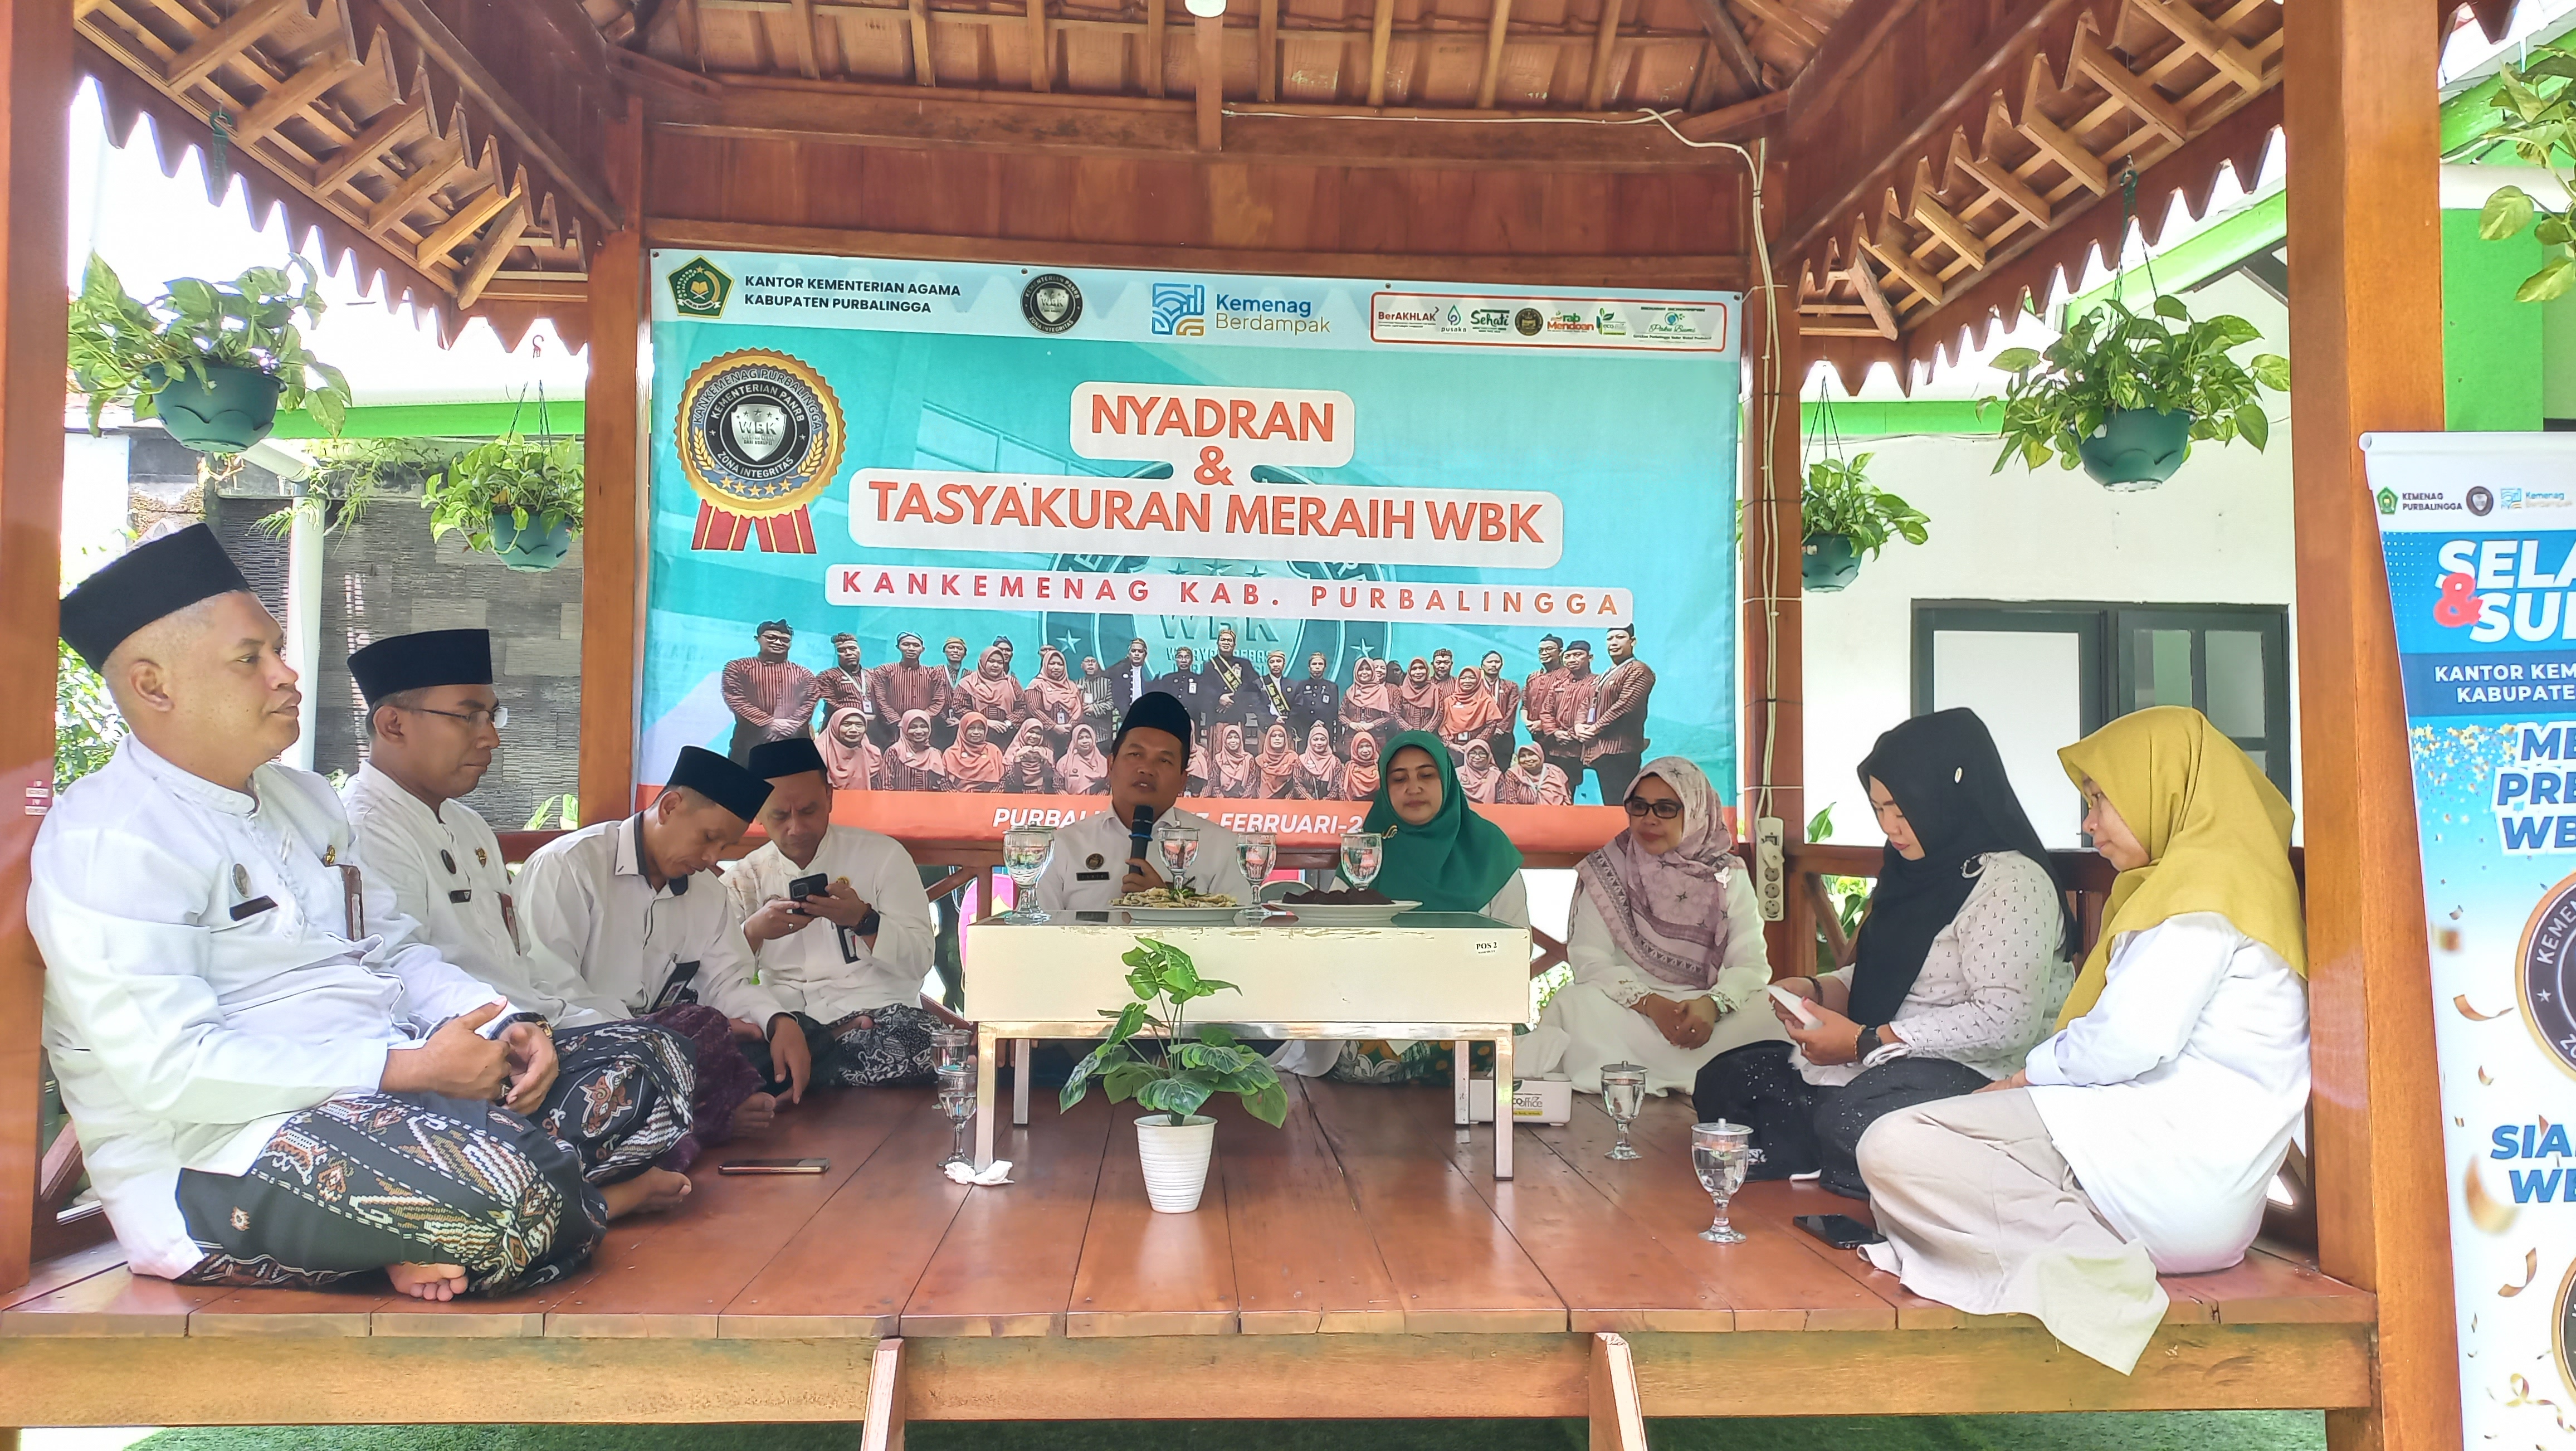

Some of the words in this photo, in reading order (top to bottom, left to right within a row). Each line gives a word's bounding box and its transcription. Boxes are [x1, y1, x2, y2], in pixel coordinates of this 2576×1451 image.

[745, 275, 804, 289] KANTOR
[807, 278, 904, 294] KEMENTERIAN
[908, 283, 961, 296] AGAMA
[1065, 280, 1080, 299] PANRB
[745, 294, 829, 308] KABUPATEN
[832, 298, 931, 313] PURBALINGGA
[1216, 294, 1311, 318] Kemenag
[1029, 316, 1042, 329] ZONA
[1042, 319, 1074, 333] INTEGRITAS
[1216, 313, 1331, 336] Berdampak
[1378, 311, 1436, 322] BerAKHLAK
[1470, 309, 1509, 328] Sehati
[1547, 321, 1594, 331] Mendoan
[692, 368, 758, 425] KANKEMENAG
[761, 369, 822, 431] PURBALINGGA
[710, 384, 778, 420] KEMENTERIAN
[779, 391, 805, 422] PANRB
[739, 421, 777, 435] WBK
[1092, 394, 1334, 442] NYADRAN
[716, 451, 739, 474] ZONA
[740, 456, 794, 478] INTEGRITAS
[1193, 445, 1235, 486] &
[2402, 493, 2444, 501] KEMENAG
[869, 481, 1211, 533] TASYAKURAN
[1225, 493, 1415, 539] MERAIH
[1424, 500, 1545, 543] WBK
[842, 571, 1149, 602] KANKEMENAG
[1180, 581, 1280, 606] KAB.
[1311, 585, 1618, 616] PURBALINGGA
[2433, 572, 2483, 627] &
[2434, 665, 2524, 682] KANTOR
[2456, 684, 2576, 703] KABUPATE
[992, 808, 1106, 828] PURBA
[2490, 1124, 2576, 1159] SIA
